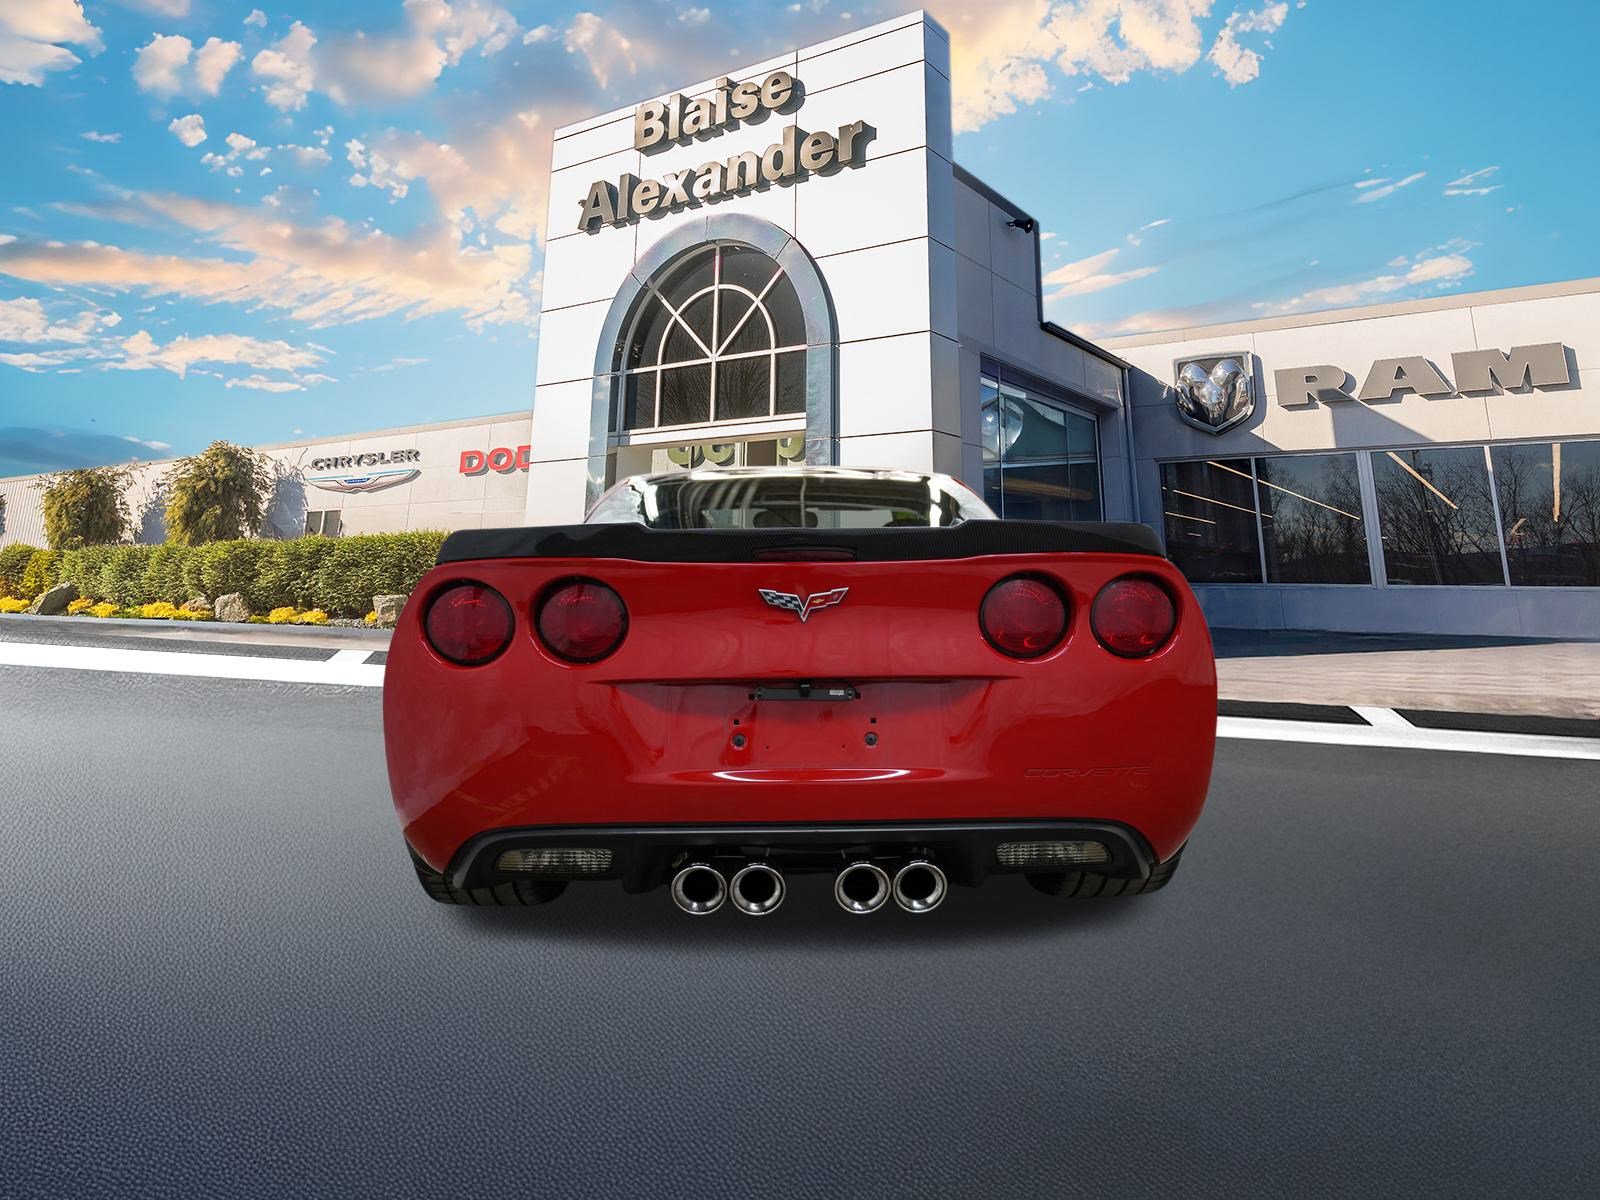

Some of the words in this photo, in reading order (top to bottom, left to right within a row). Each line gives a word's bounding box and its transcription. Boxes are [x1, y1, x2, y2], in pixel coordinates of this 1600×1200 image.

[634, 71, 801, 155] Blaise
[577, 120, 874, 234] Alexander
[1275, 342, 1572, 408] RAM
[312, 449, 420, 471] CHRYSLER
[1024, 767, 1151, 777] CORVETTE
